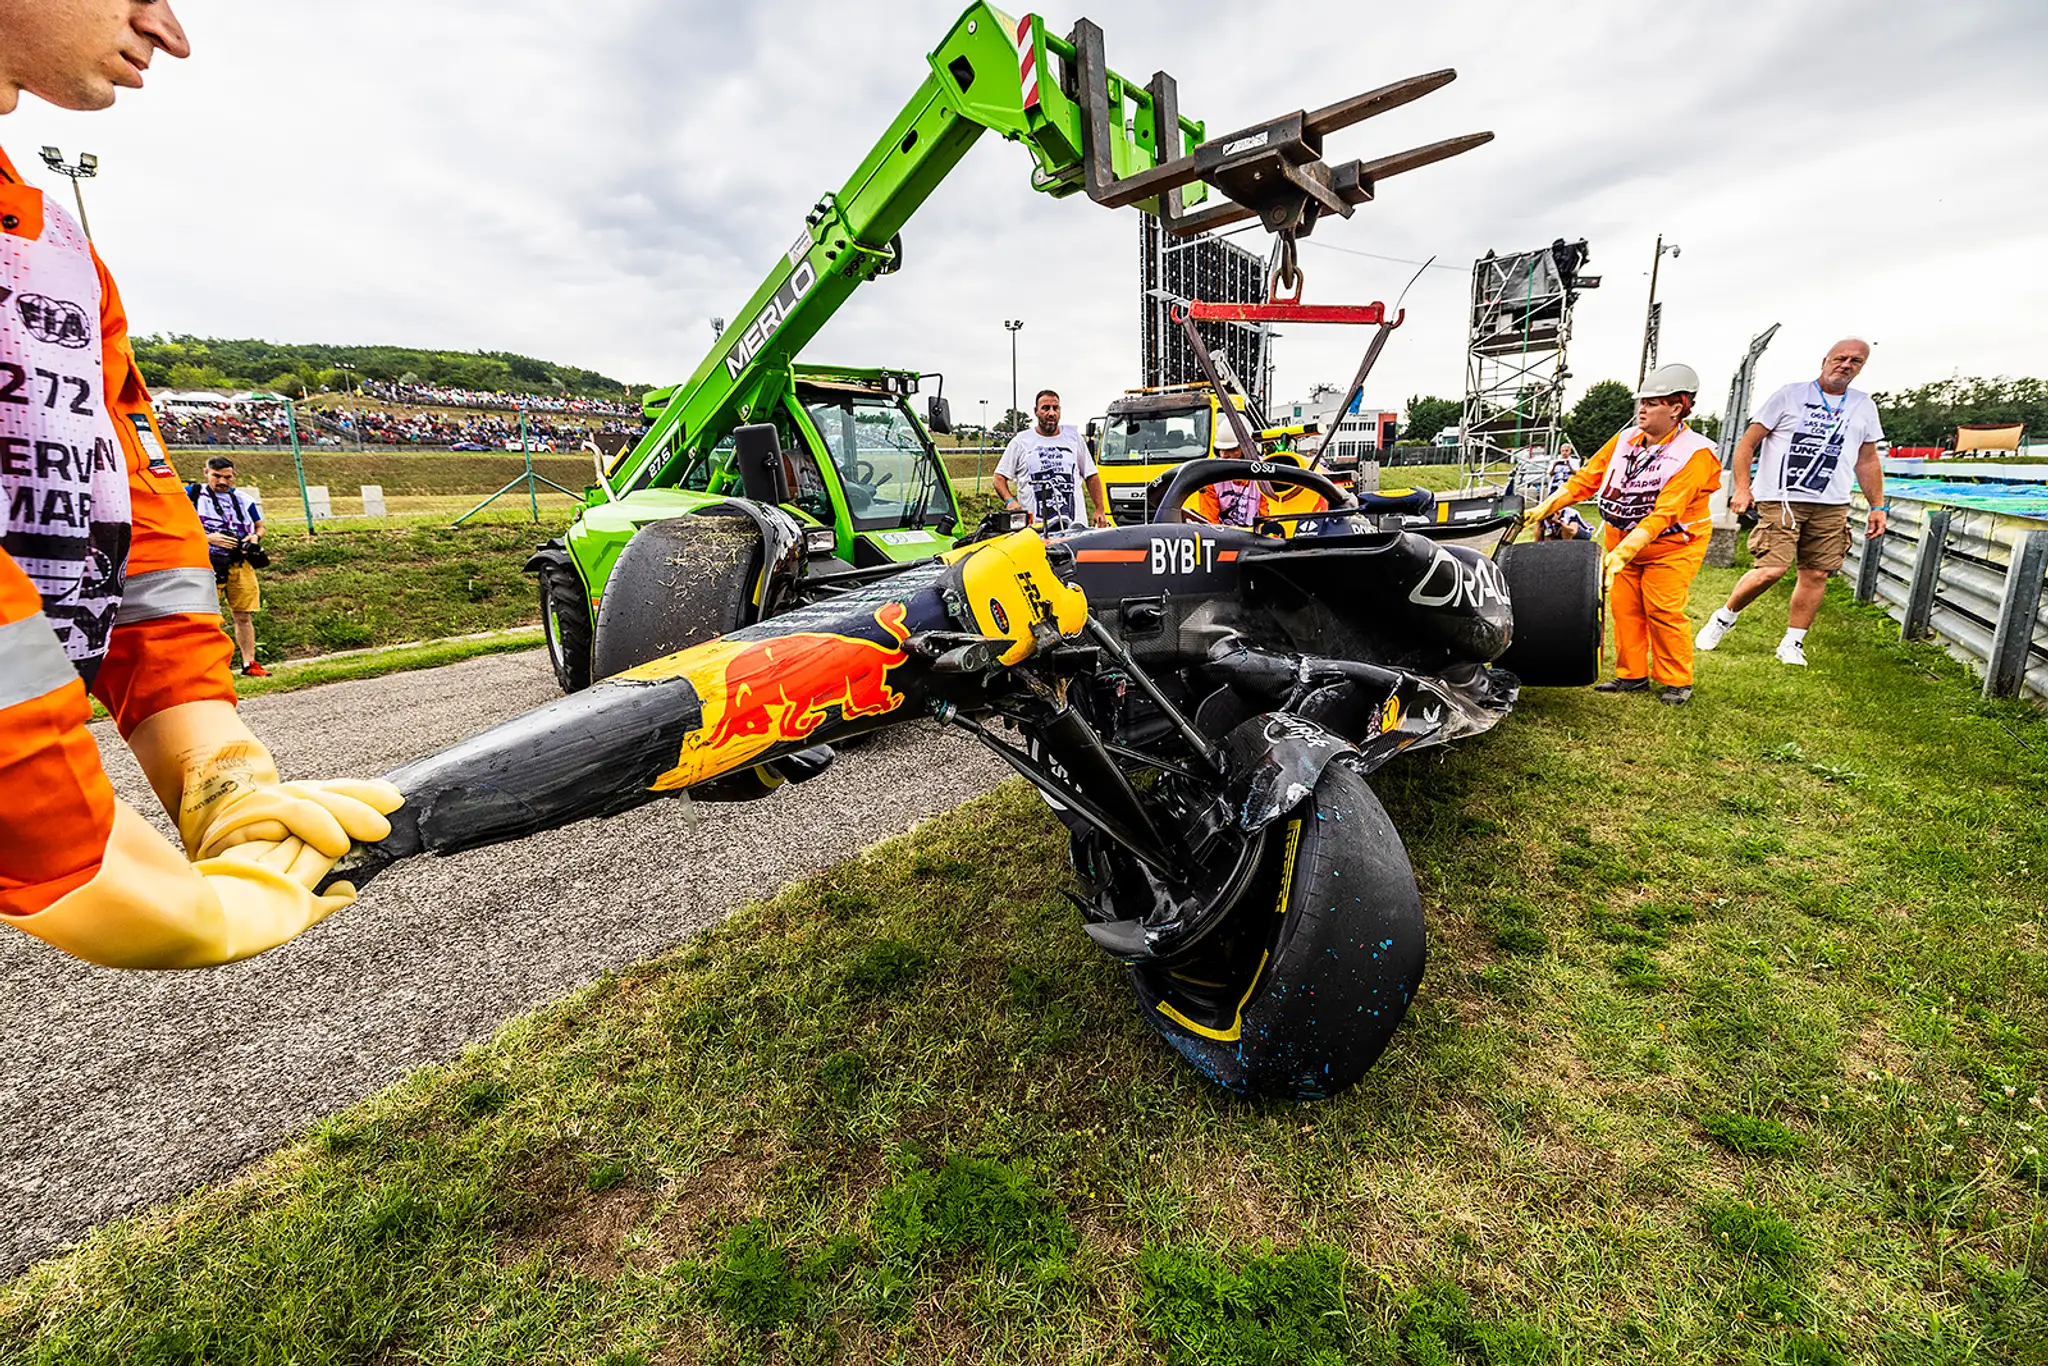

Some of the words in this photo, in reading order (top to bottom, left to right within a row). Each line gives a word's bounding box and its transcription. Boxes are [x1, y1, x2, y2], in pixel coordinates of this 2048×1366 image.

[20, 300, 87, 340] FIA
[725, 260, 815, 380] MERLO
[1151, 532, 1216, 575] BYBIT
